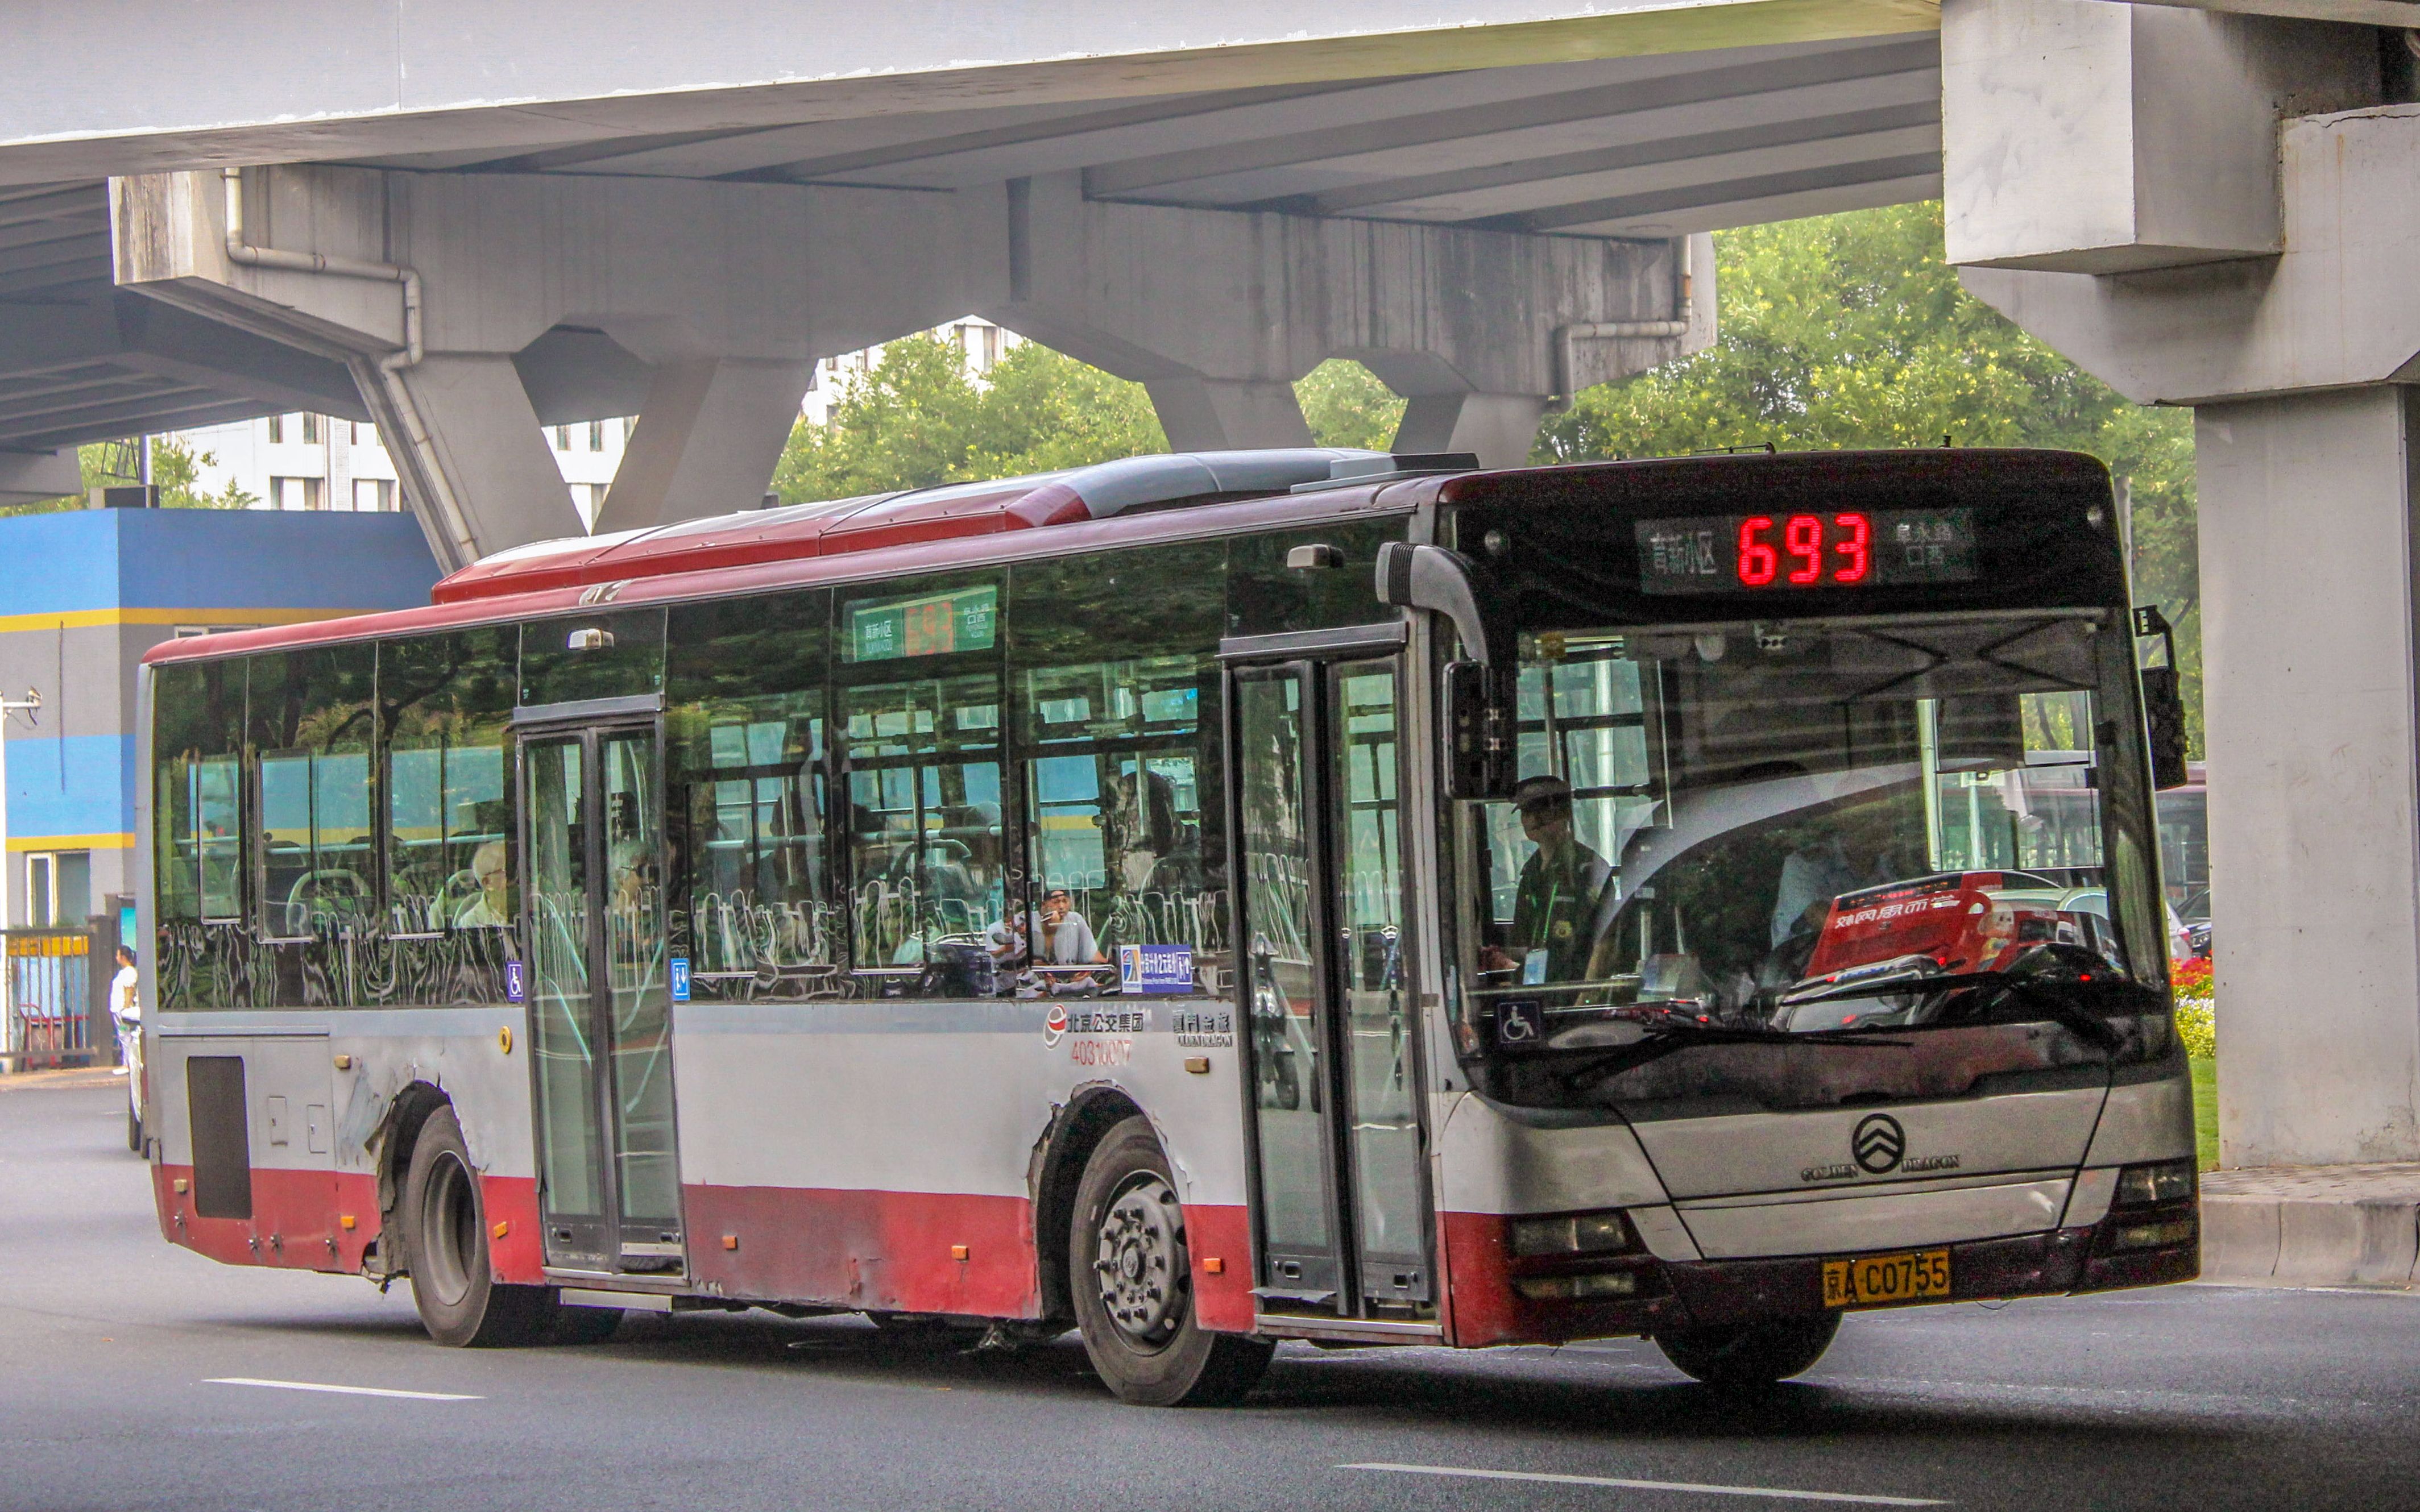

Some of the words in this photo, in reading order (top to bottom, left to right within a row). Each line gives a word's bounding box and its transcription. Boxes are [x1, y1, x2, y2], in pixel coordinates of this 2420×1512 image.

[1738, 513, 1869, 586] 693
[1067, 1012, 1144, 1033] 北京公交集团
[1801, 1165, 1859, 1181] GOLDEN
[1903, 1155, 1959, 1172] DRAGON
